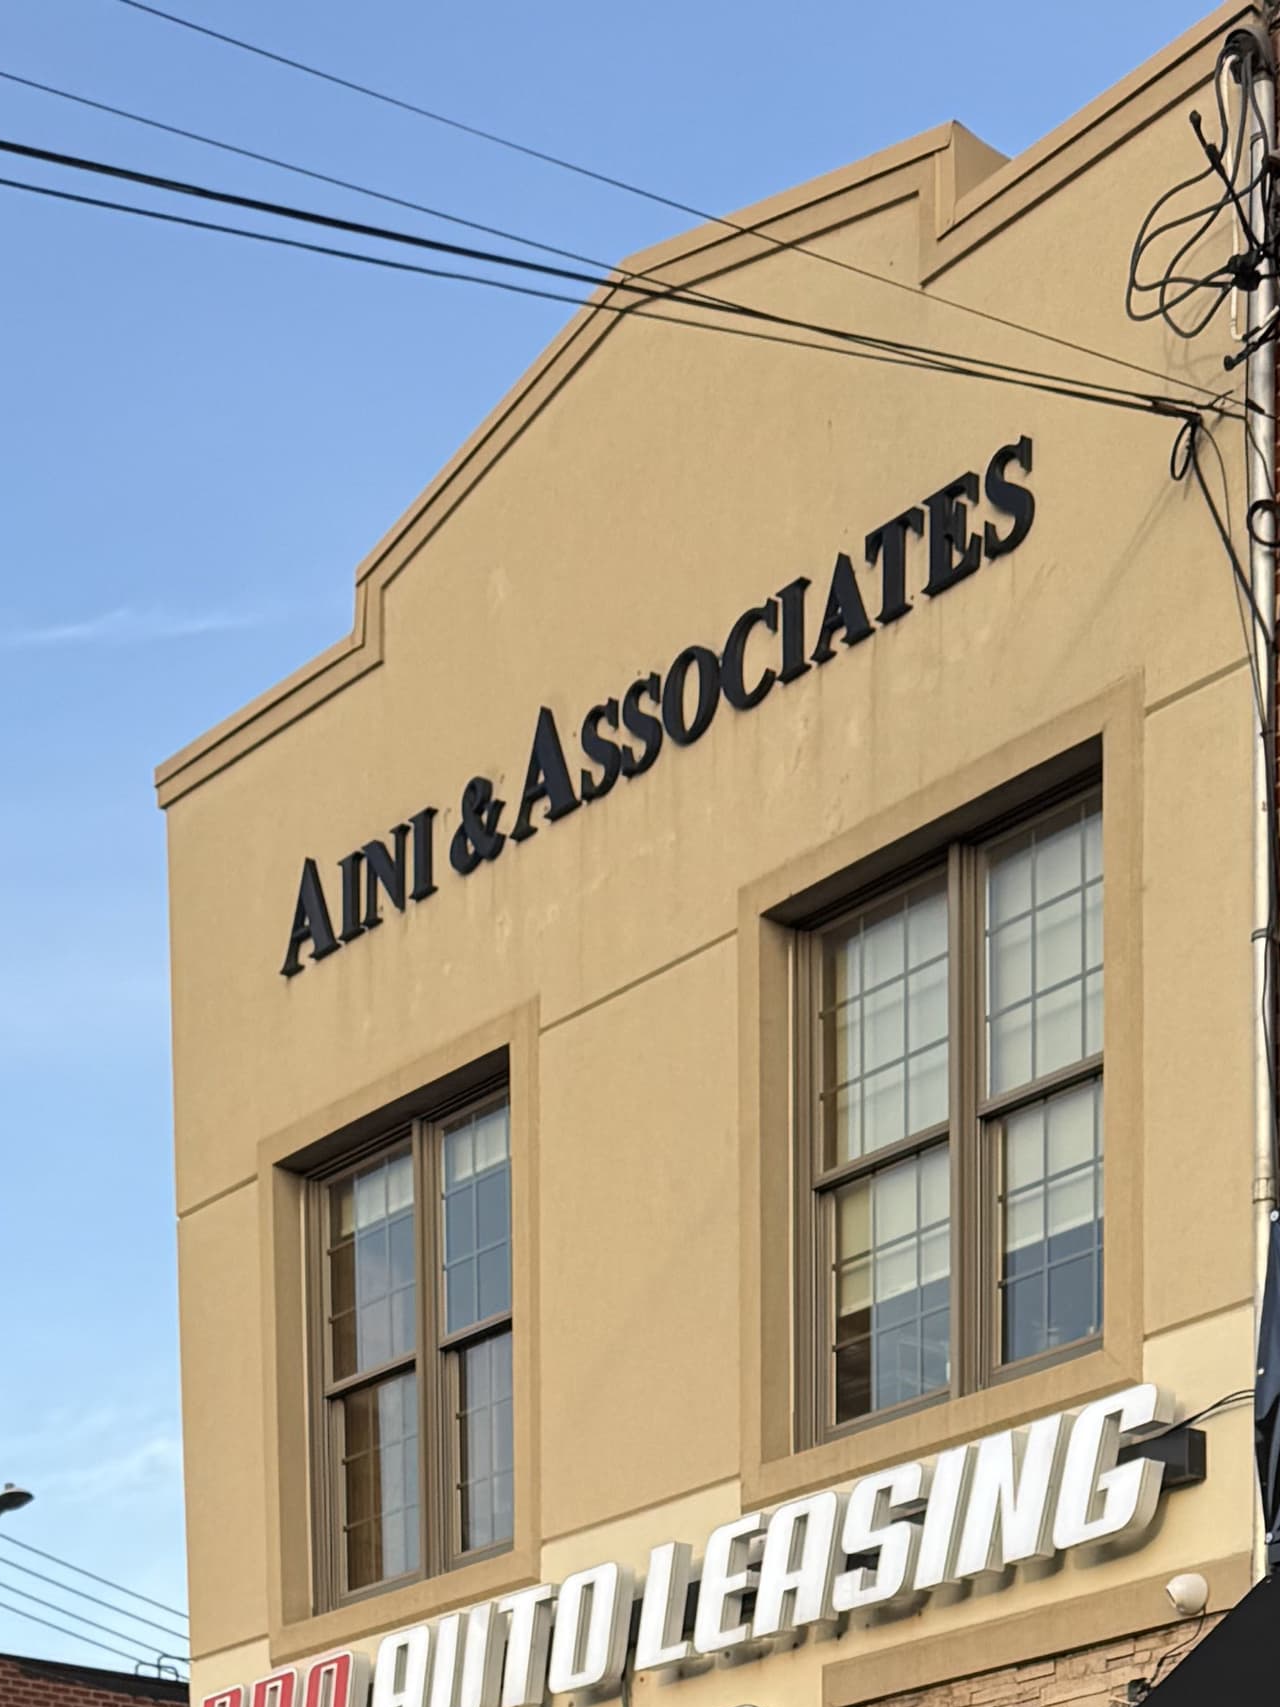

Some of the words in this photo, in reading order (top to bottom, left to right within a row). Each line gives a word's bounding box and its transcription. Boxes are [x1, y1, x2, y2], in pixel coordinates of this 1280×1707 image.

[280, 806, 438, 978] AINI
[450, 775, 505, 875] &
[511, 434, 1036, 843] ASSOCIATES
[634, 1383, 1176, 1672] LEASING
